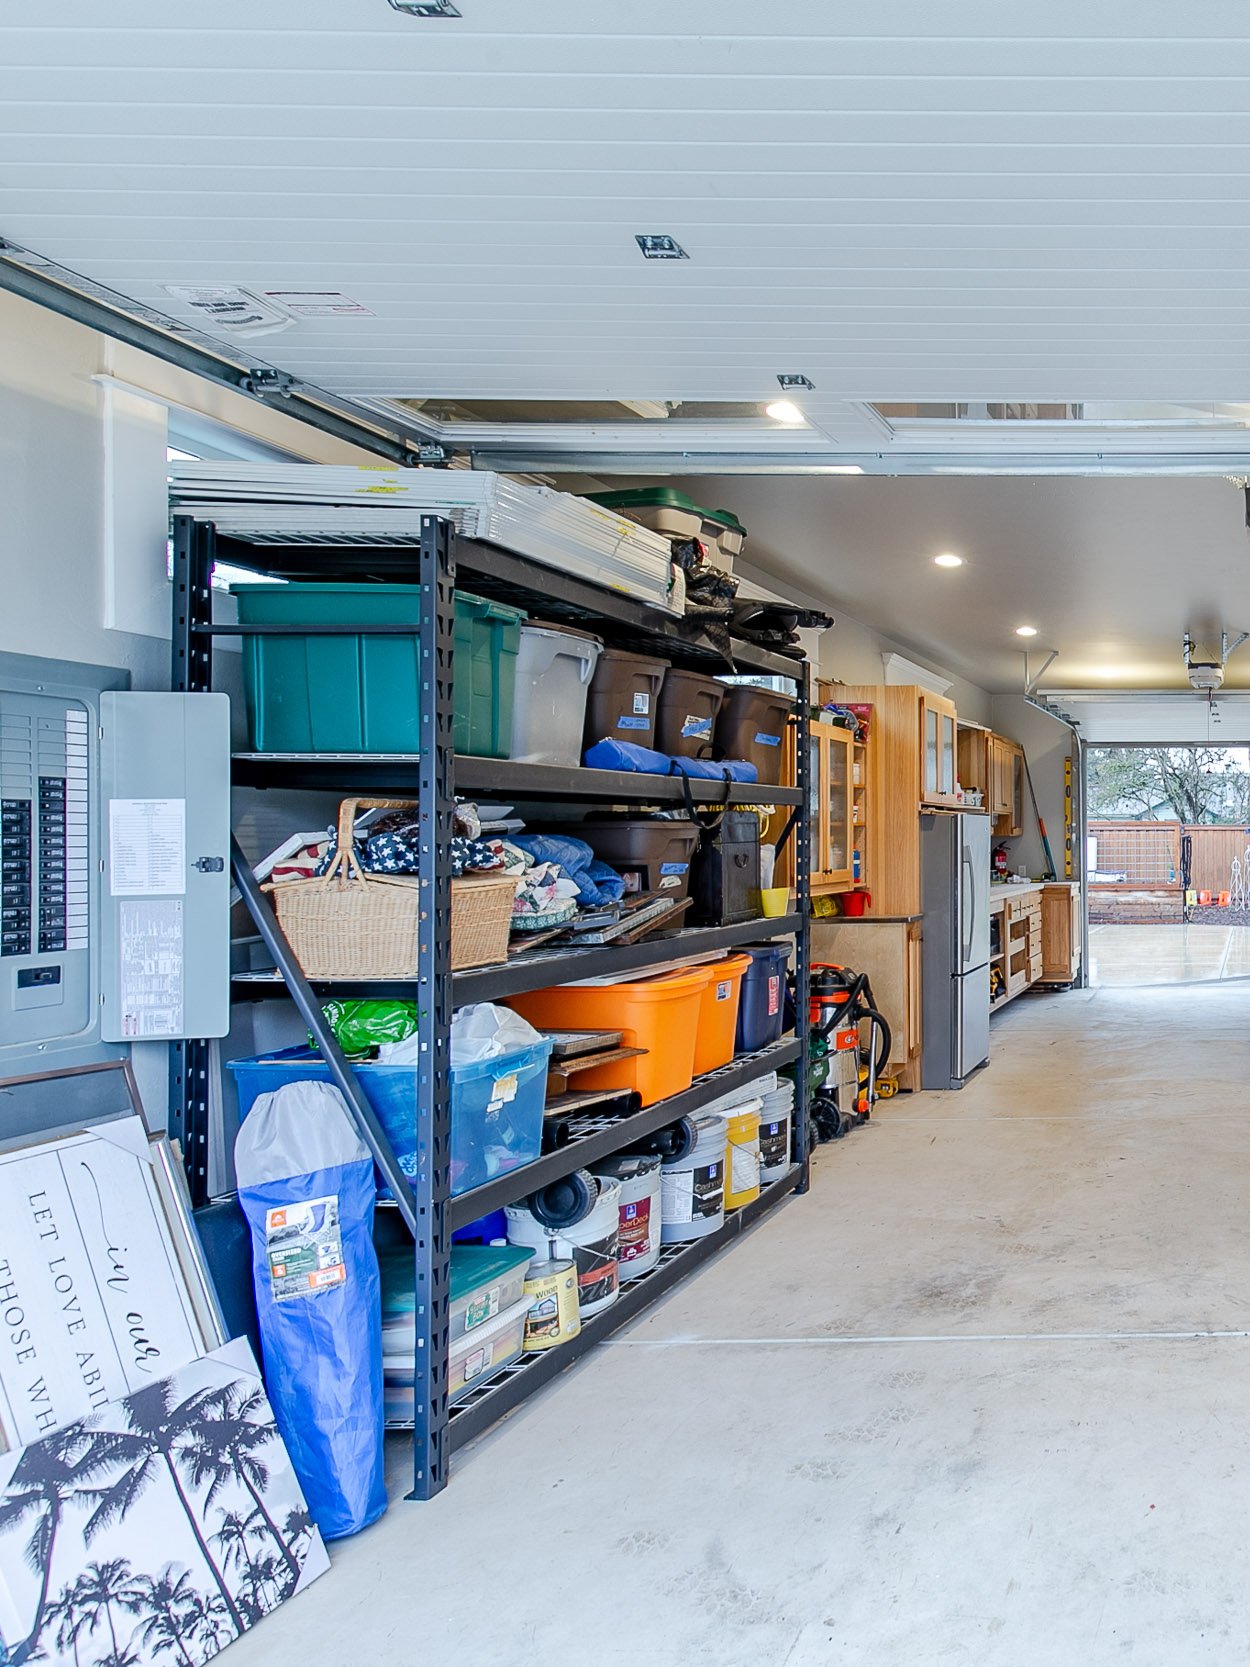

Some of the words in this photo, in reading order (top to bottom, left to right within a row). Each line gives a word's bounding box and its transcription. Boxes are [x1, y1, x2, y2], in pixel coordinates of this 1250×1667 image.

[28, 1190, 60, 1241] LET
[48, 1256, 87, 1335] LOVE
[0, 1259, 37, 1365] THOSE
[26, 1375, 58, 1433] WH
[125, 1311, 161, 1374] our
